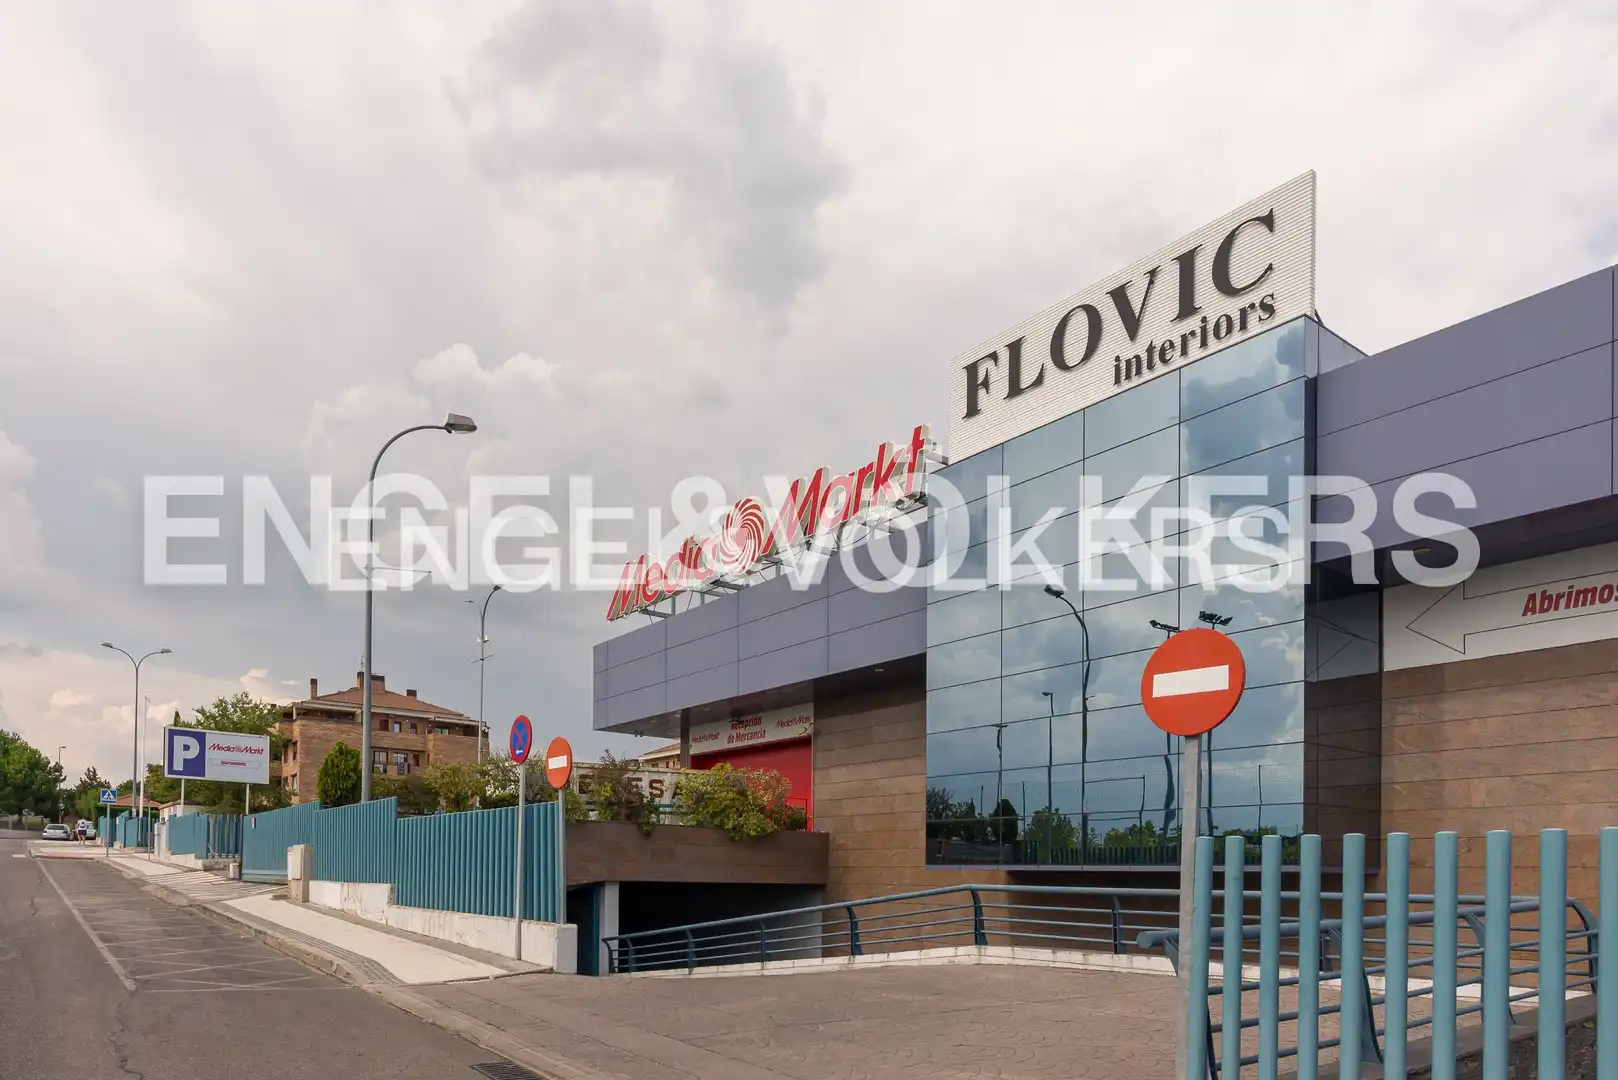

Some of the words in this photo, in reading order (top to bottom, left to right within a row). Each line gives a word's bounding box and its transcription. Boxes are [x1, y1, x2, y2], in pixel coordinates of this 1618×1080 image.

[962, 207, 1274, 420] FLOVIC
[1113, 292, 1276, 386] interiors
[1521, 583, 1618, 618] Abrimo
[173, 735, 200, 771] P
